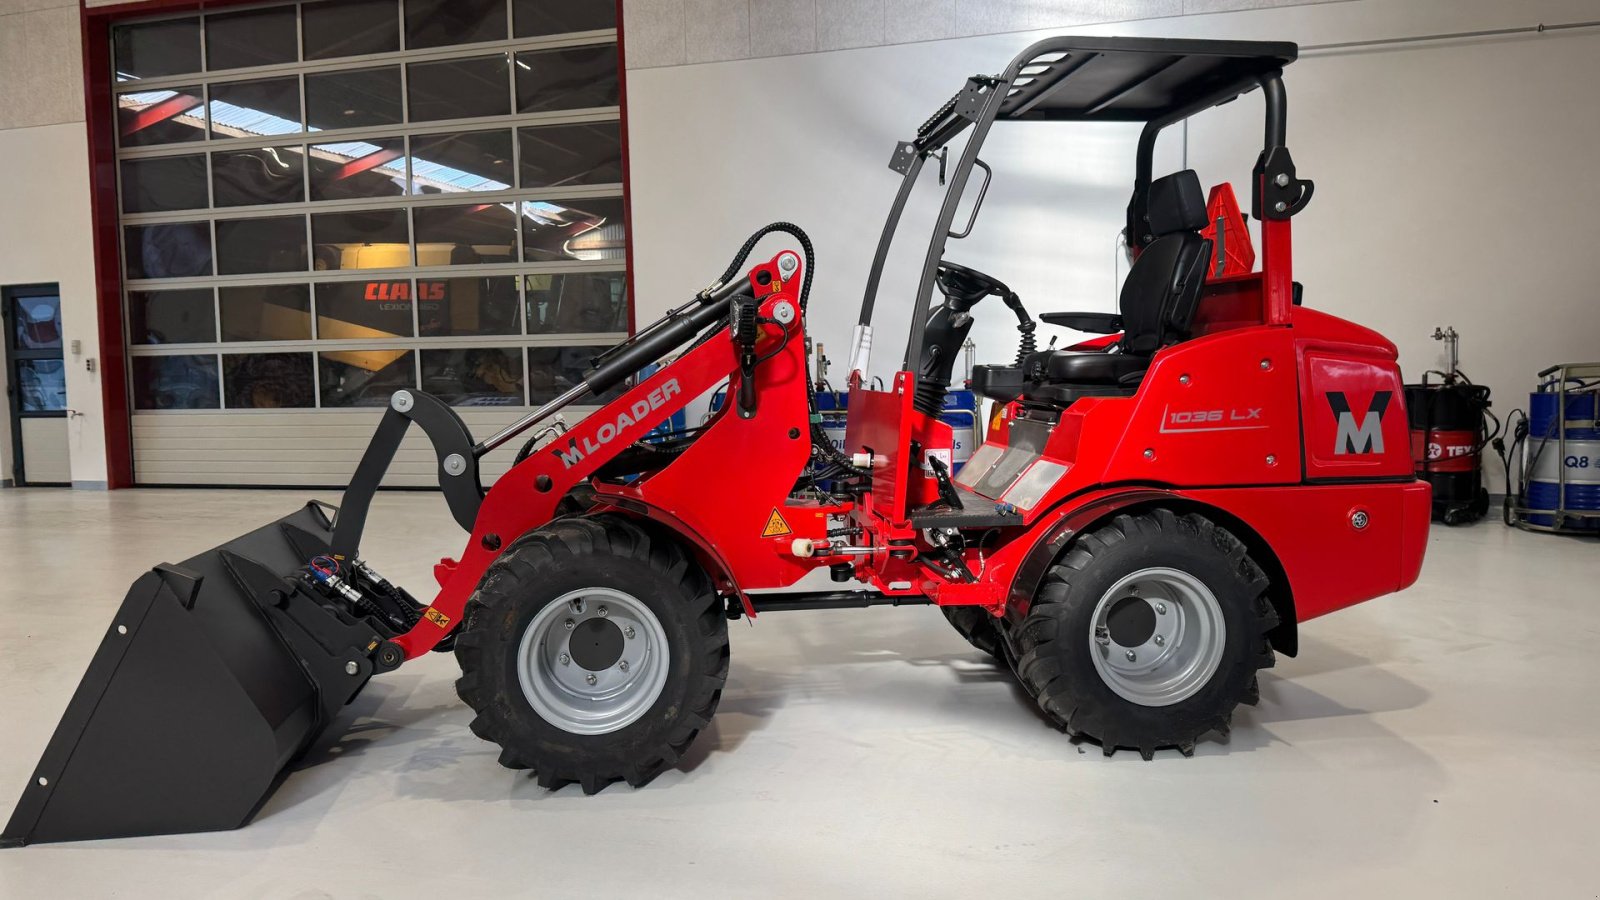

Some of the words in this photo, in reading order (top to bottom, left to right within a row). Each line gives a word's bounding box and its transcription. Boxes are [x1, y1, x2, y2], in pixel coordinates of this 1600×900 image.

[582, 378, 682, 456] LOADER
[1170, 410, 1224, 424] 1036
[1230, 408, 1262, 421] LX
[1446, 445, 1474, 457] TEX
[1564, 455, 1589, 469] Q8
